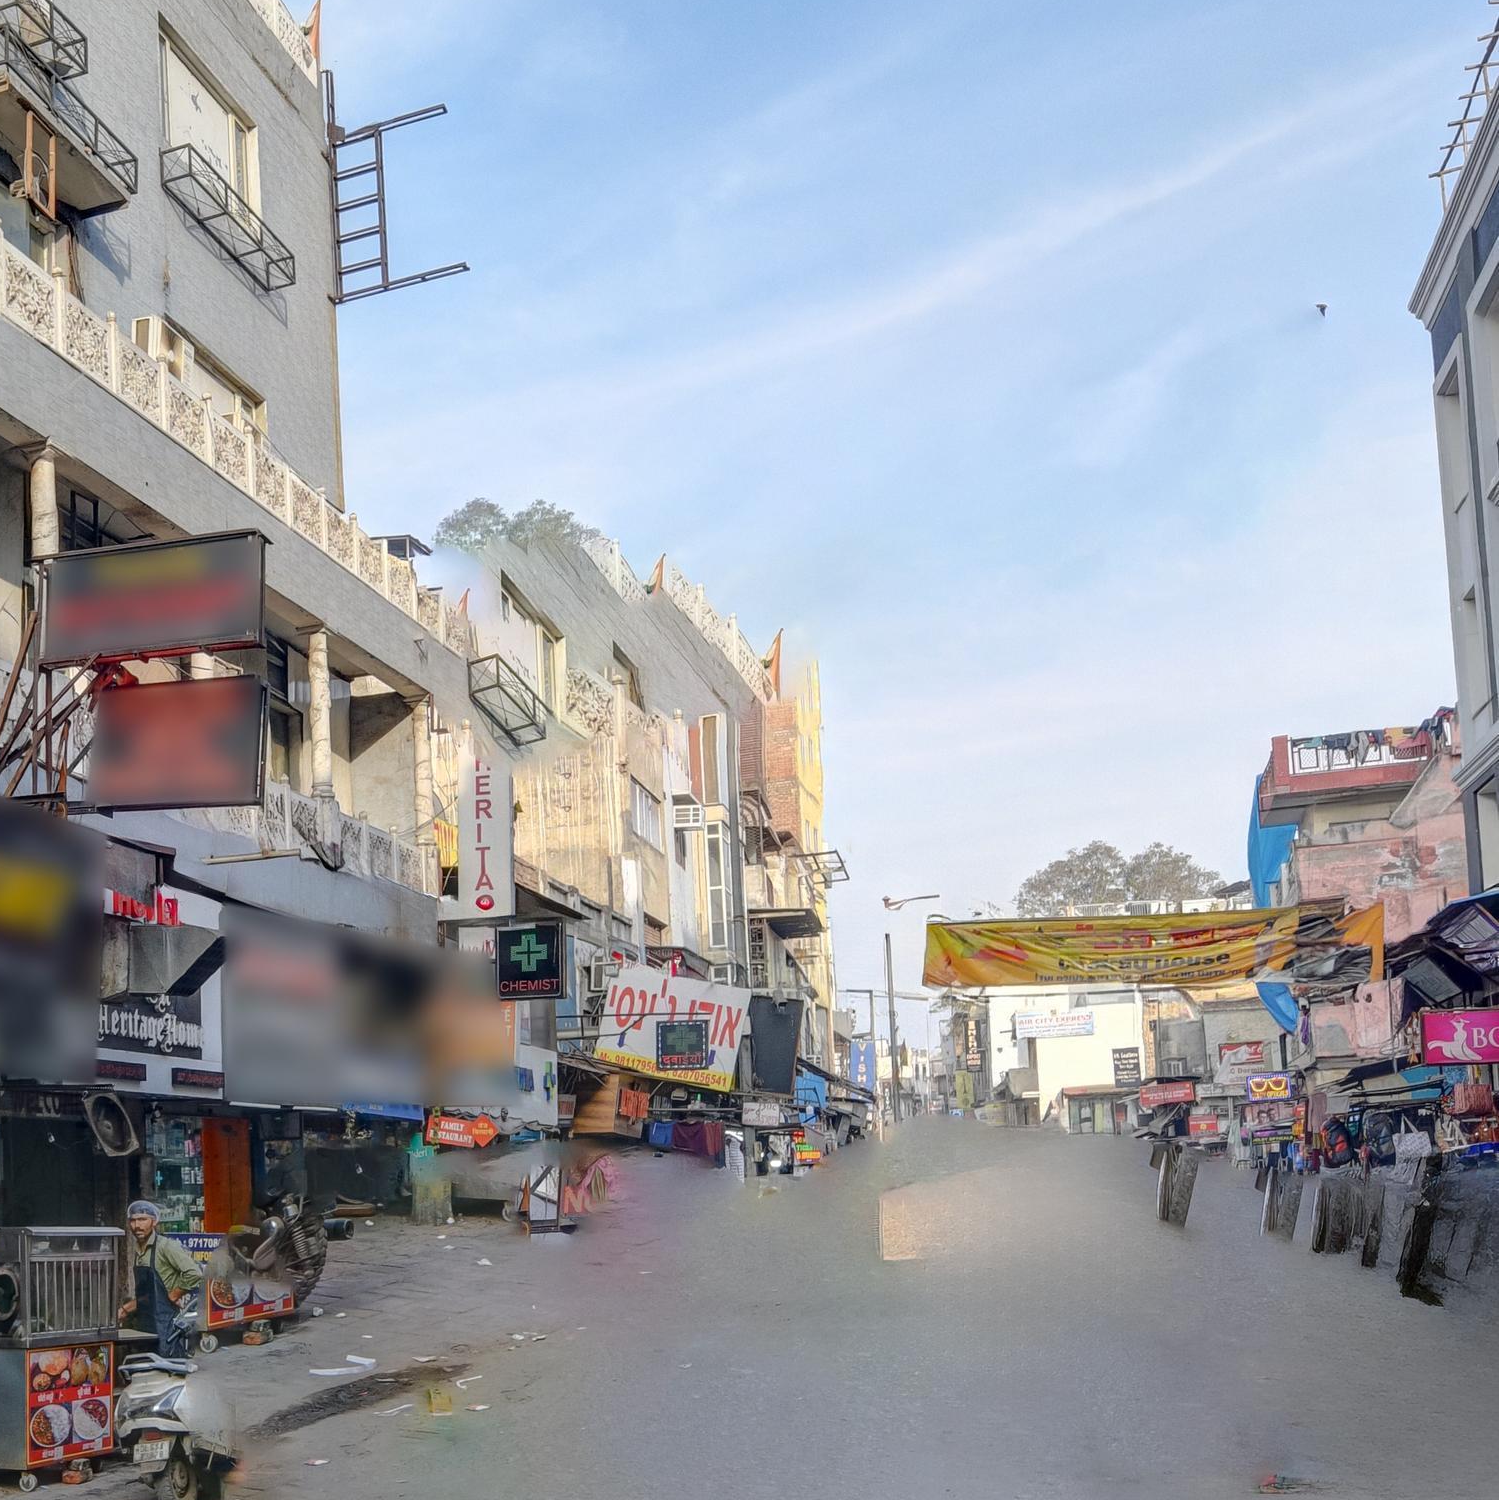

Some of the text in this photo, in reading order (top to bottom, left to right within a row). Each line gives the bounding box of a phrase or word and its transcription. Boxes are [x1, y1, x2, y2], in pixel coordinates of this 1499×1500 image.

[500, 977, 560, 992] CHEMIST
[440, 1120, 465, 1132] FAMILY
[429, 1129, 473, 1144] RSTAURANT
